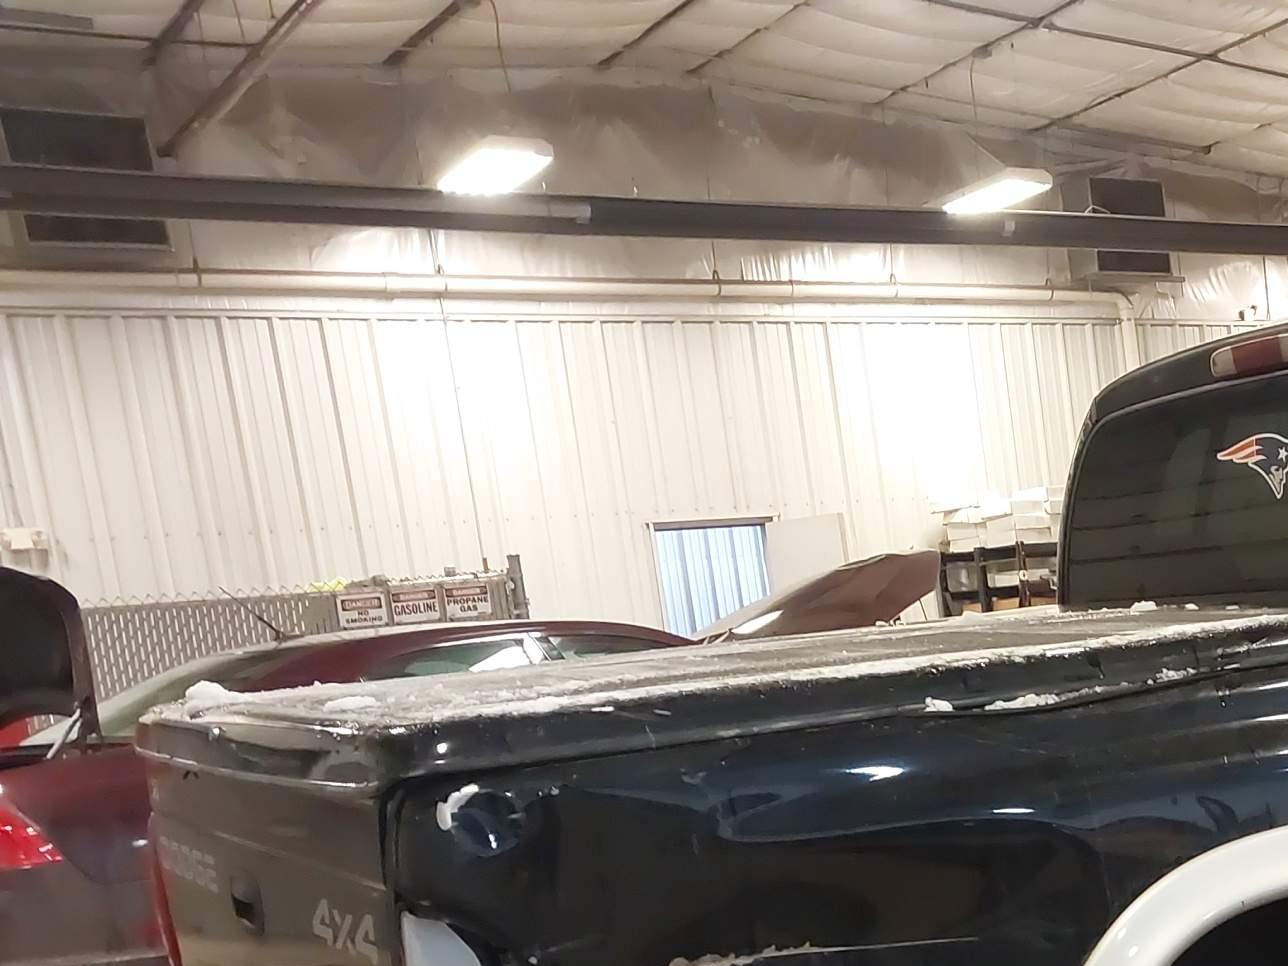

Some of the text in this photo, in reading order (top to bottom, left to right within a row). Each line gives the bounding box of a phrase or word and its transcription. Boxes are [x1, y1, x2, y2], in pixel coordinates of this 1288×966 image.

[447, 596, 489, 606] PROPANE
[394, 602, 438, 617] GASOLINE
[460, 604, 478, 613] GAS
[346, 616, 383, 625] SMOKING
